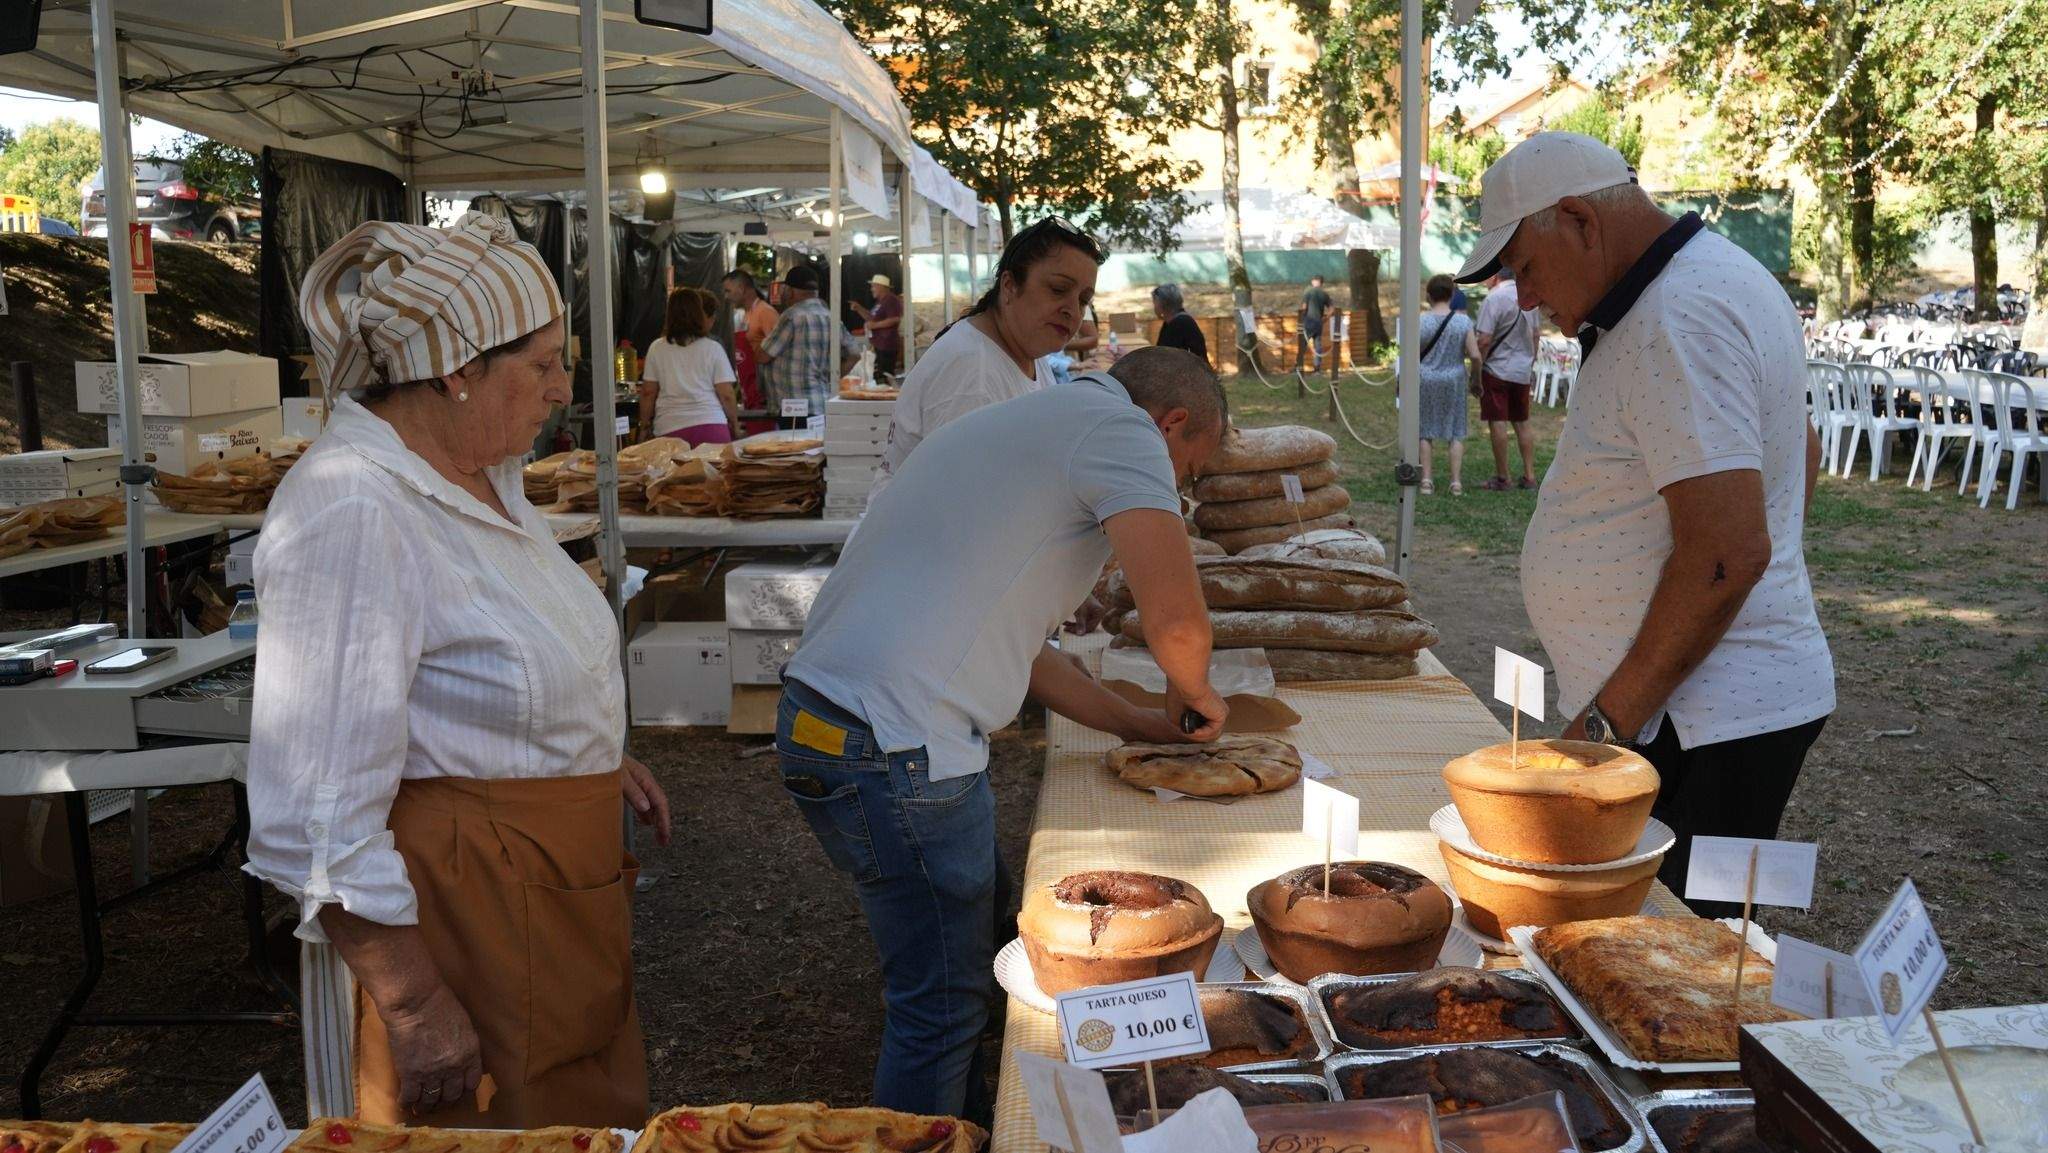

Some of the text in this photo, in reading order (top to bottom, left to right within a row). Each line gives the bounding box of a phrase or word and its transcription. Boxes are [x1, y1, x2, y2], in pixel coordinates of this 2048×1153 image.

[1902, 940, 1929, 982] 10,00
[1085, 988, 1167, 1010] TARTA QUESO
[1125, 1016, 1177, 1040] 10,00
[1183, 1014, 1196, 1030] €
[266, 1114, 278, 1132] €
